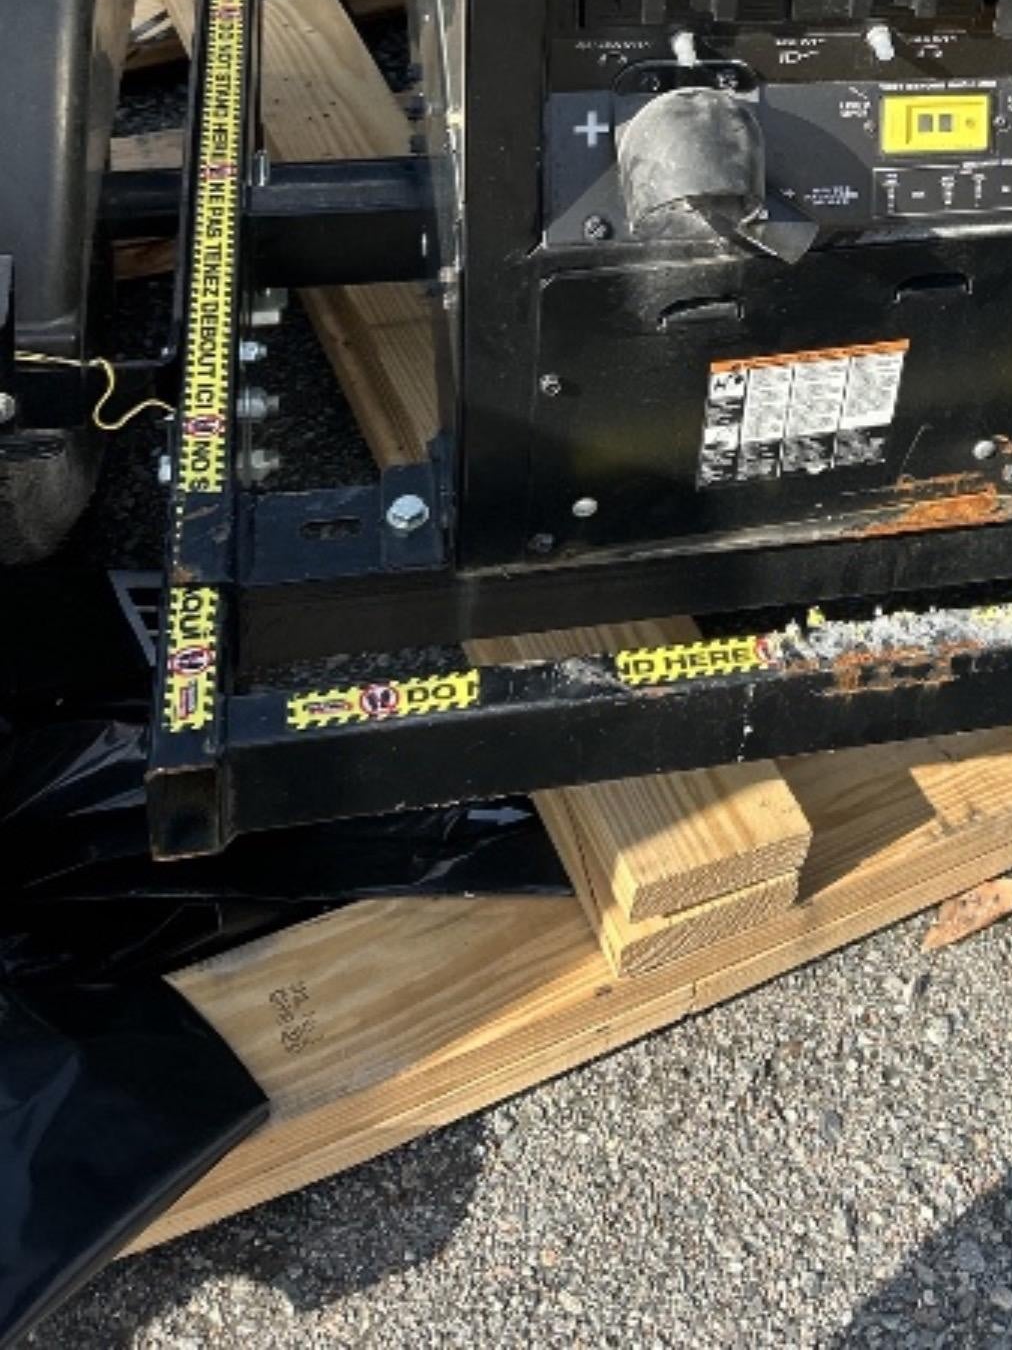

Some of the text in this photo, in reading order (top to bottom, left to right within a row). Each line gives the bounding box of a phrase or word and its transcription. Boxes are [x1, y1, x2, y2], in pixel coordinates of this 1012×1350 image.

[206, 206, 224, 238] PAS
[197, 302, 220, 379] DEBOUT
[194, 384, 215, 408] ICI
[190, 440, 211, 472] NO
[664, 647, 751, 671] HERE
[407, 683, 457, 703] DO
